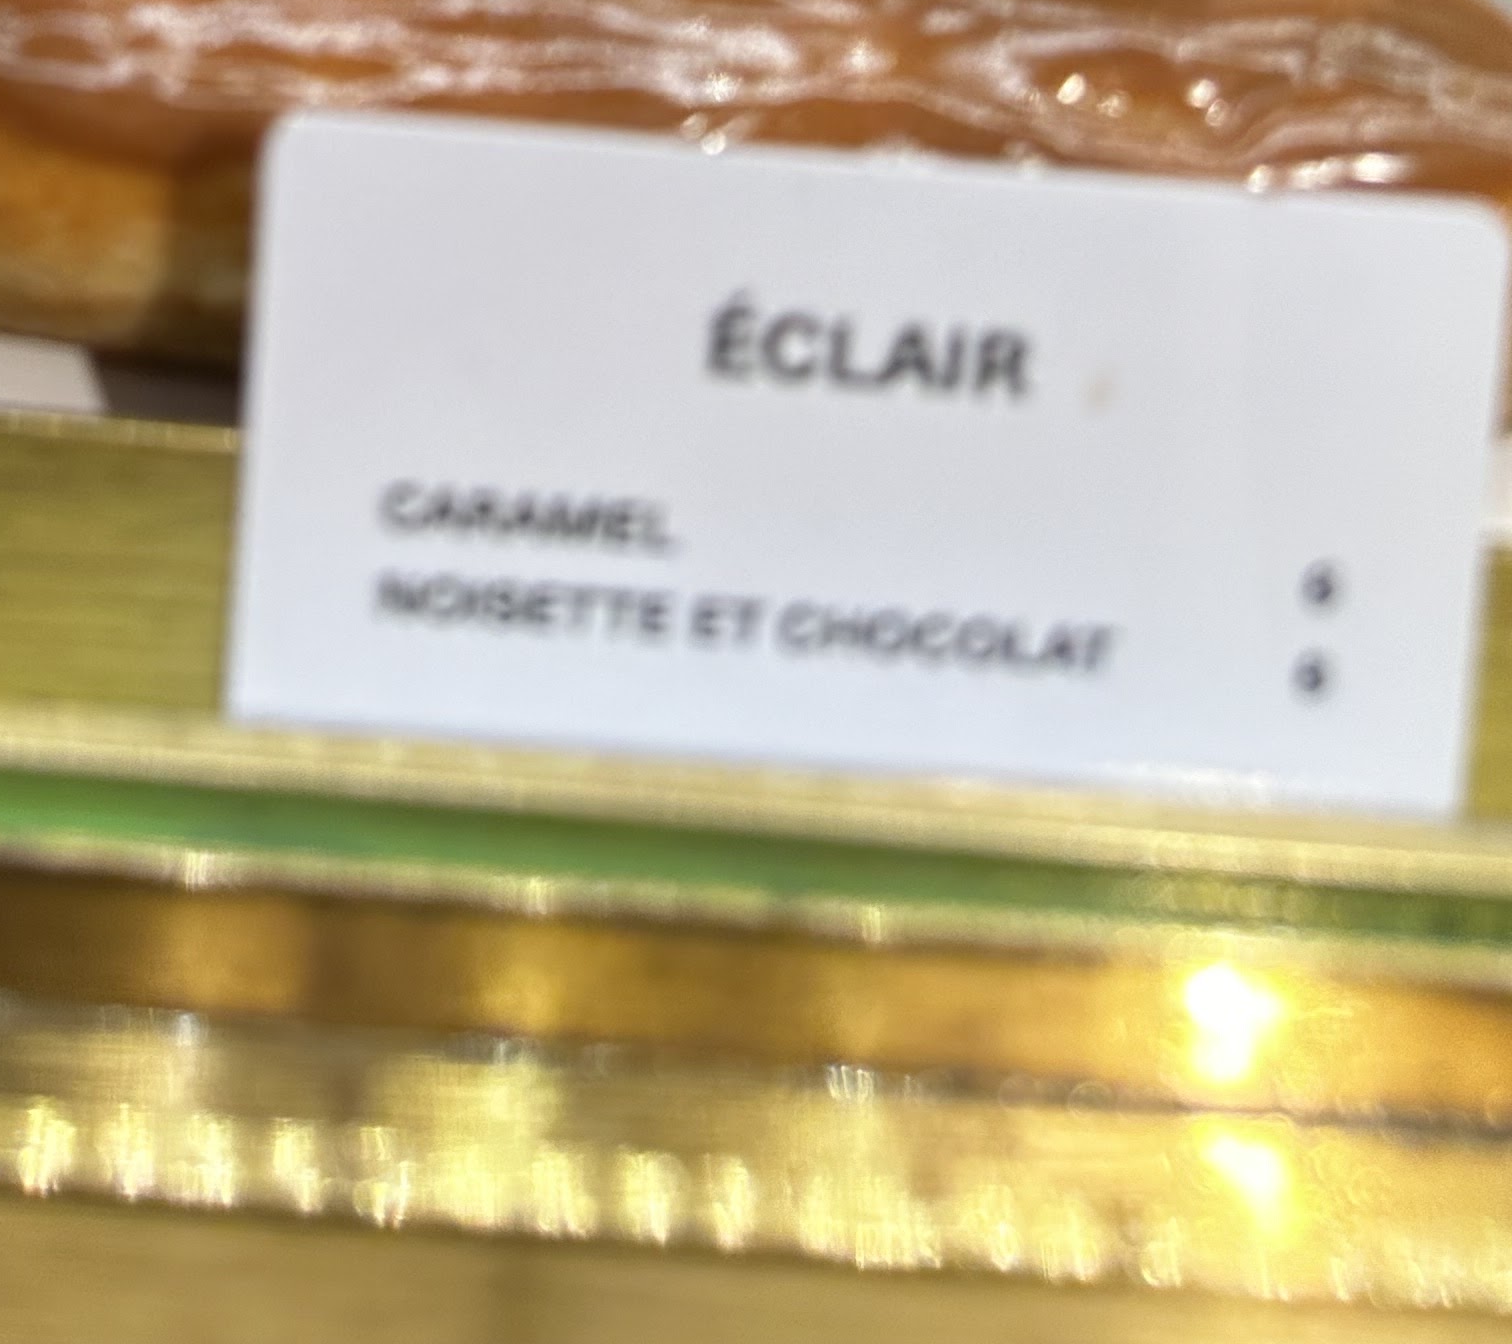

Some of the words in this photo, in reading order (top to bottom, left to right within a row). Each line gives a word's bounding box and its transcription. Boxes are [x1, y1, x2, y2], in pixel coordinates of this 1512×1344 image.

[705, 289, 1034, 404] ÉCLAIR
[379, 482, 675, 555] CARAMEL
[375, 572, 673, 644] NOISETTE
[689, 596, 765, 649] ET
[776, 603, 1115, 675] CHOCOLAT
